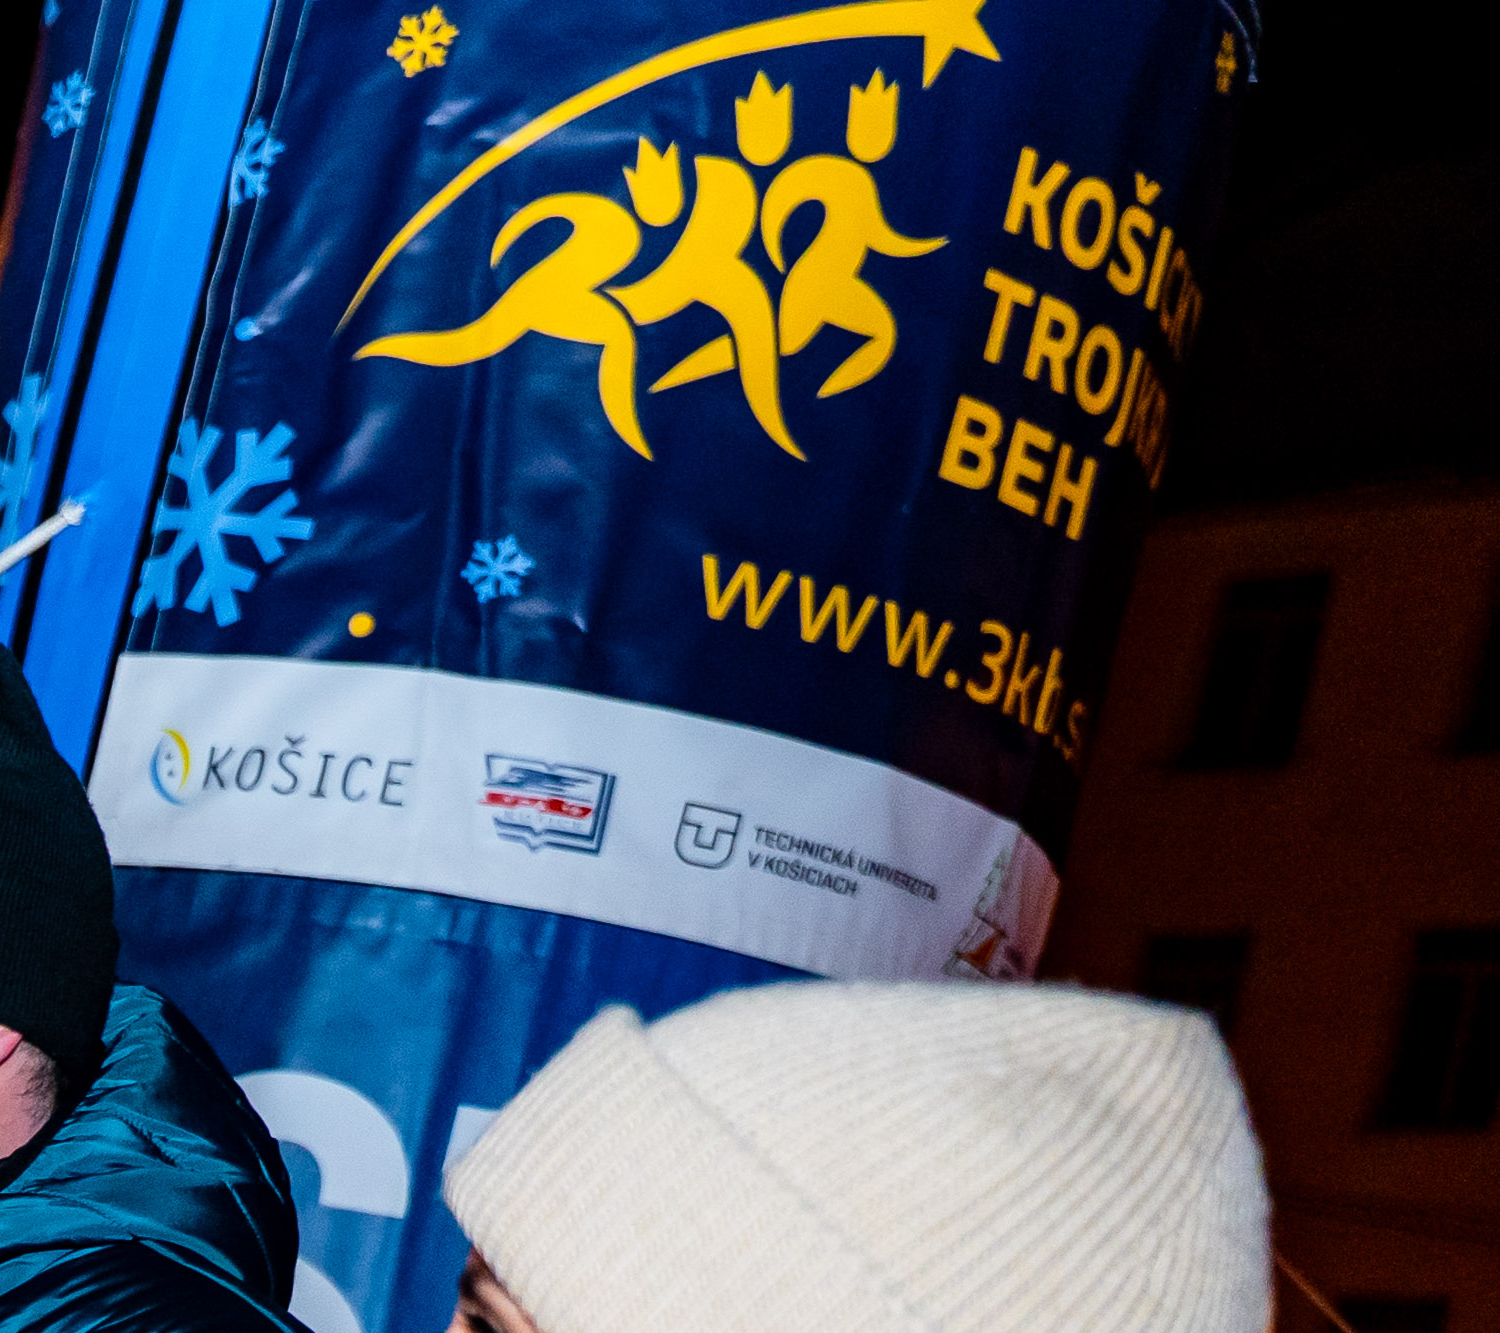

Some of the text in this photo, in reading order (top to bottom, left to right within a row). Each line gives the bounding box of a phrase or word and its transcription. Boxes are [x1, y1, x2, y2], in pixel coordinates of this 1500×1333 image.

[938, 393, 1100, 541] BEH
[202, 734, 414, 807] KOŠICE
[748, 850, 859, 896] V KOŠICIACH
[754, 825, 854, 869] TECHNICKÁ
